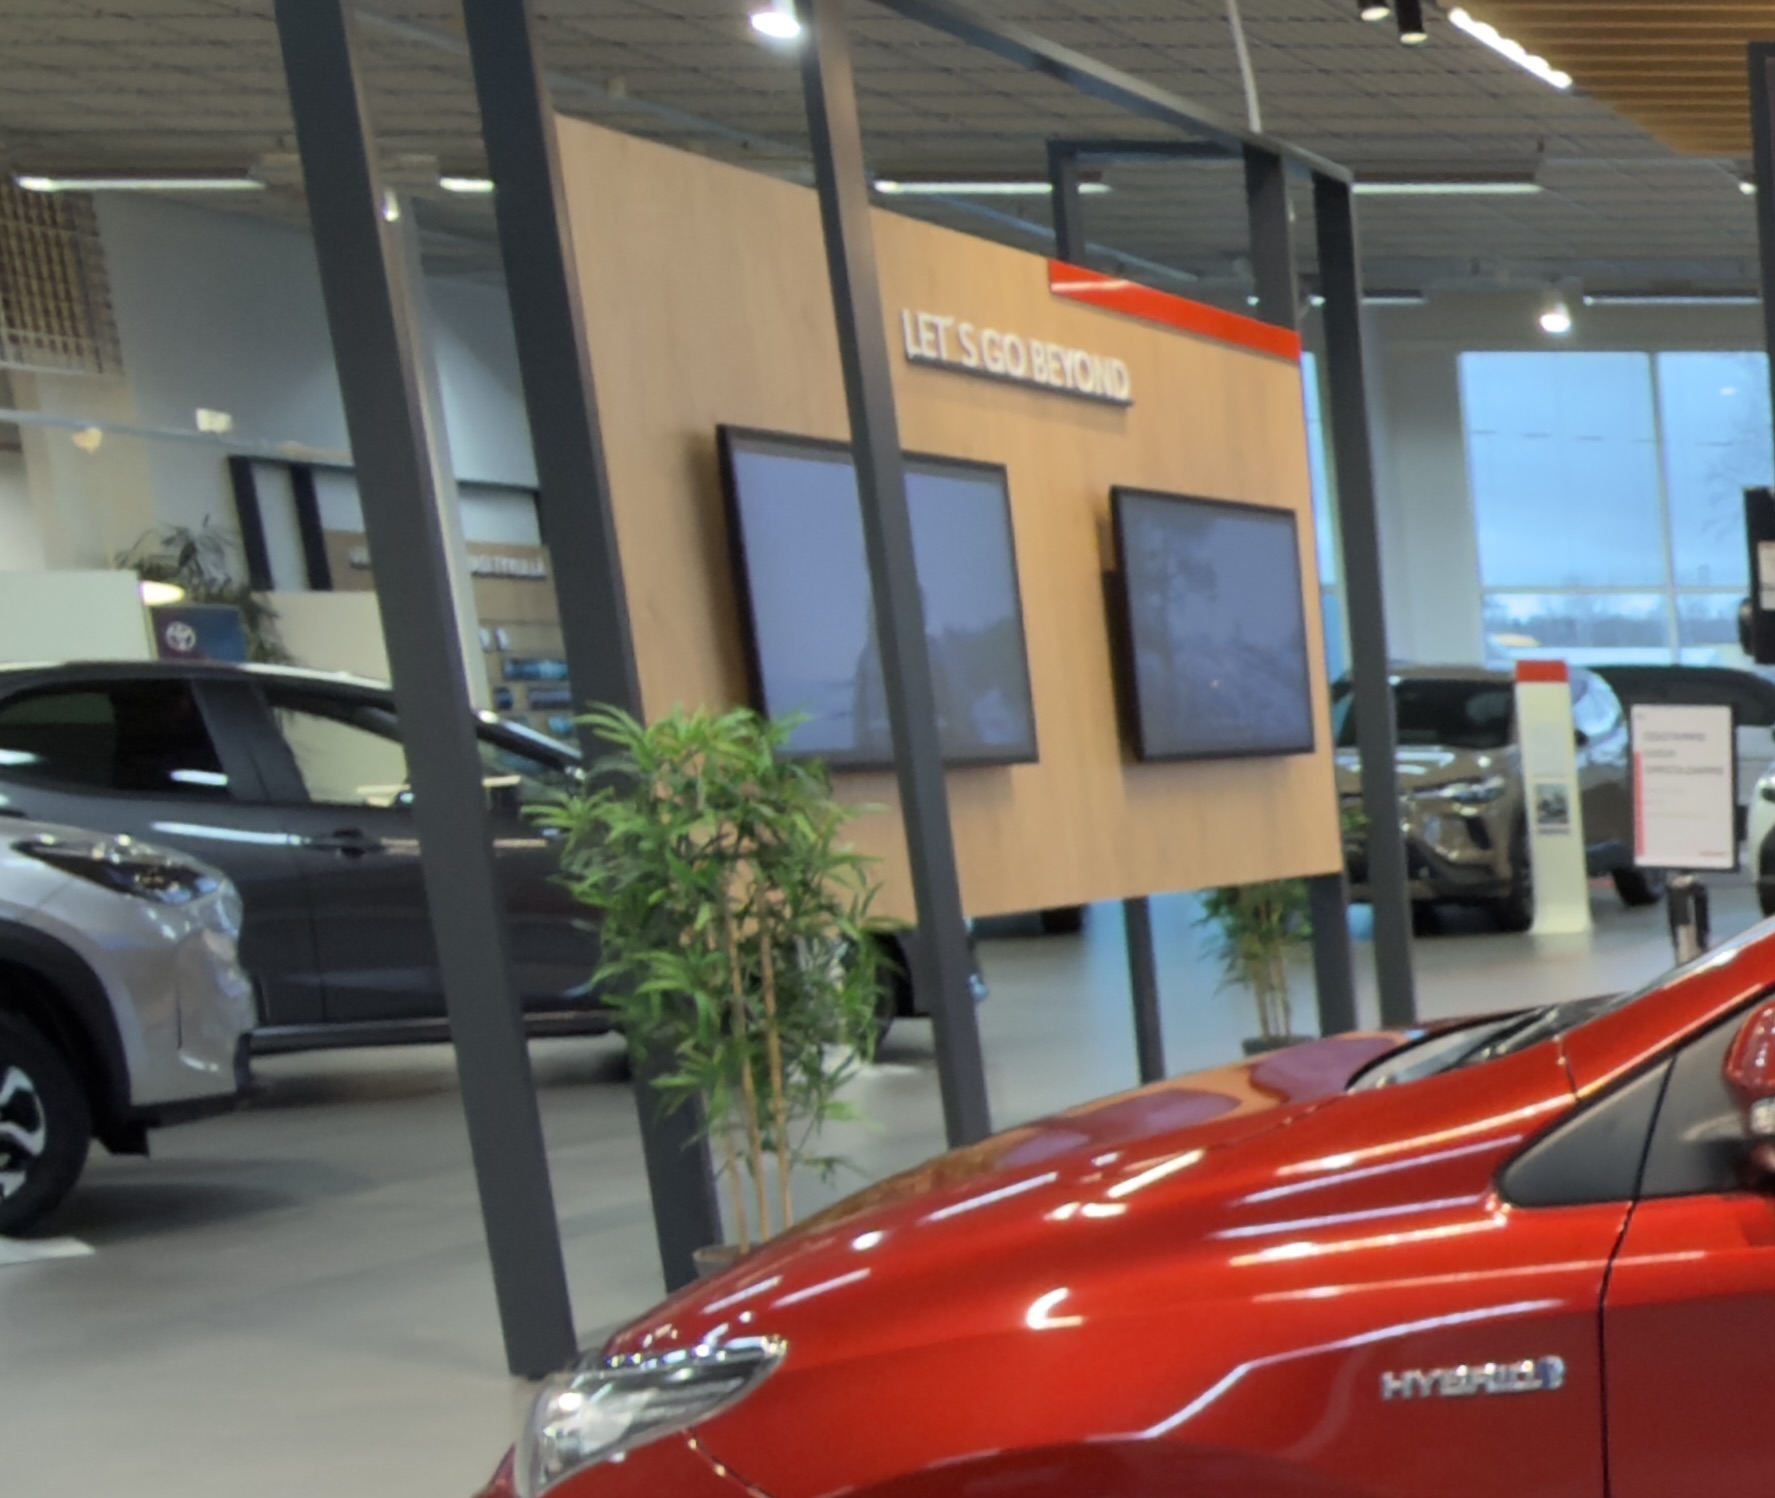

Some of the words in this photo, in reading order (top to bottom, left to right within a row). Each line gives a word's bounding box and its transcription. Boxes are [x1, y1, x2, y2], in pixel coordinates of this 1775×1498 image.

[980, 328, 1028, 378] GO
[1028, 338, 1132, 401] BEYOND
[1380, 1359, 1542, 1401] HYBRID
